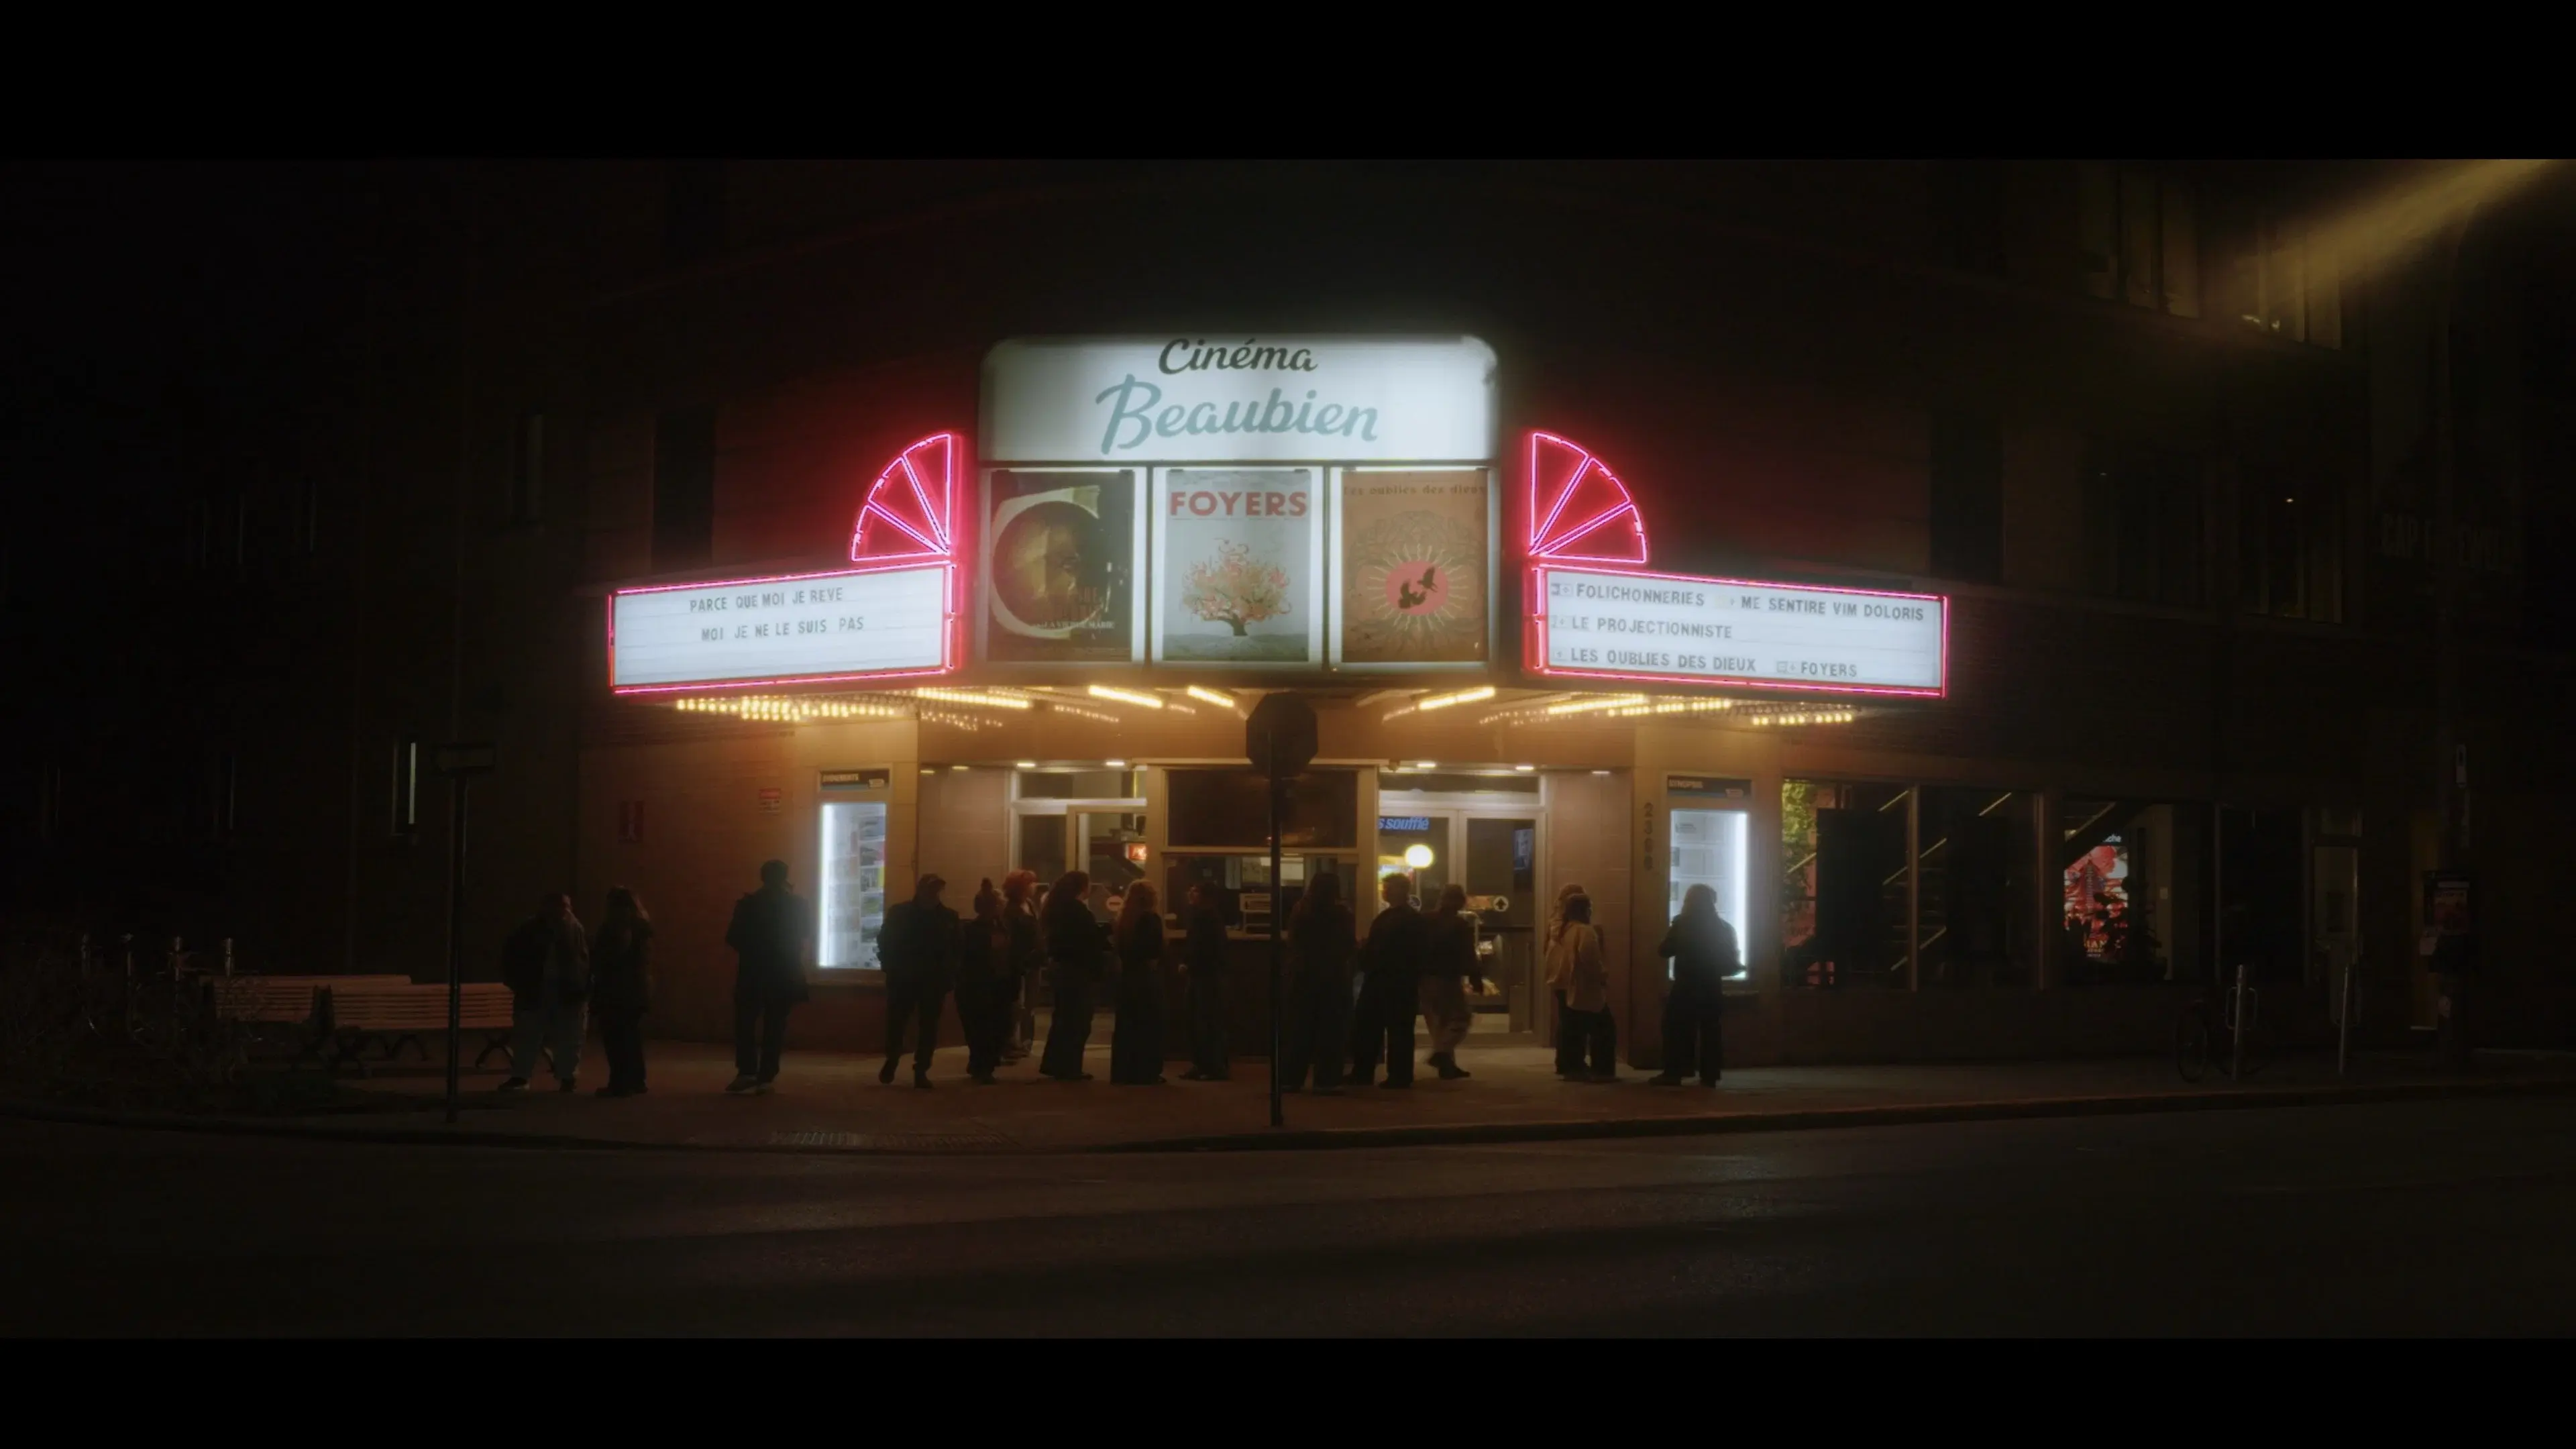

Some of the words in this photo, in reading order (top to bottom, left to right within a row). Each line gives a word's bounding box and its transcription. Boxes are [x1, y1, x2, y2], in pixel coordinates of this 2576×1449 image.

[1158, 337, 1318, 374] Cinéma
[1095, 373, 1379, 455] Beaubien
[1169, 490, 1308, 517] FOYERS
[689, 596, 727, 612] PARCE
[736, 594, 758, 608] QUE
[761, 592, 786, 606] MOI
[792, 590, 806, 604] JE
[810, 586, 843, 602] REVE
[1576, 583, 1705, 606] FOLICHONNERIES
[1741, 596, 1761, 610] ME
[1768, 598, 1827, 615] SENTIRE
[1833, 601, 1858, 616] VIM
[1864, 604, 1924, 621] DOLORIS
[701, 627, 724, 641] MOI
[735, 625, 749, 639] JE
[755, 623, 769, 637] NE
[775, 622, 790, 636] LE
[798, 619, 827, 634] SUIS
[839, 616, 864, 631] PAS
[1572, 616, 1589, 629] LE
[1597, 617, 1732, 639] PROJECTIONNISTE
[1570, 648, 1599, 663] LES
[1607, 649, 1670, 667] OUBLIES
[1678, 654, 1707, 669] DES
[1713, 656, 1756, 672] DIEUX
[1801, 661, 1858, 678] FOYERS
